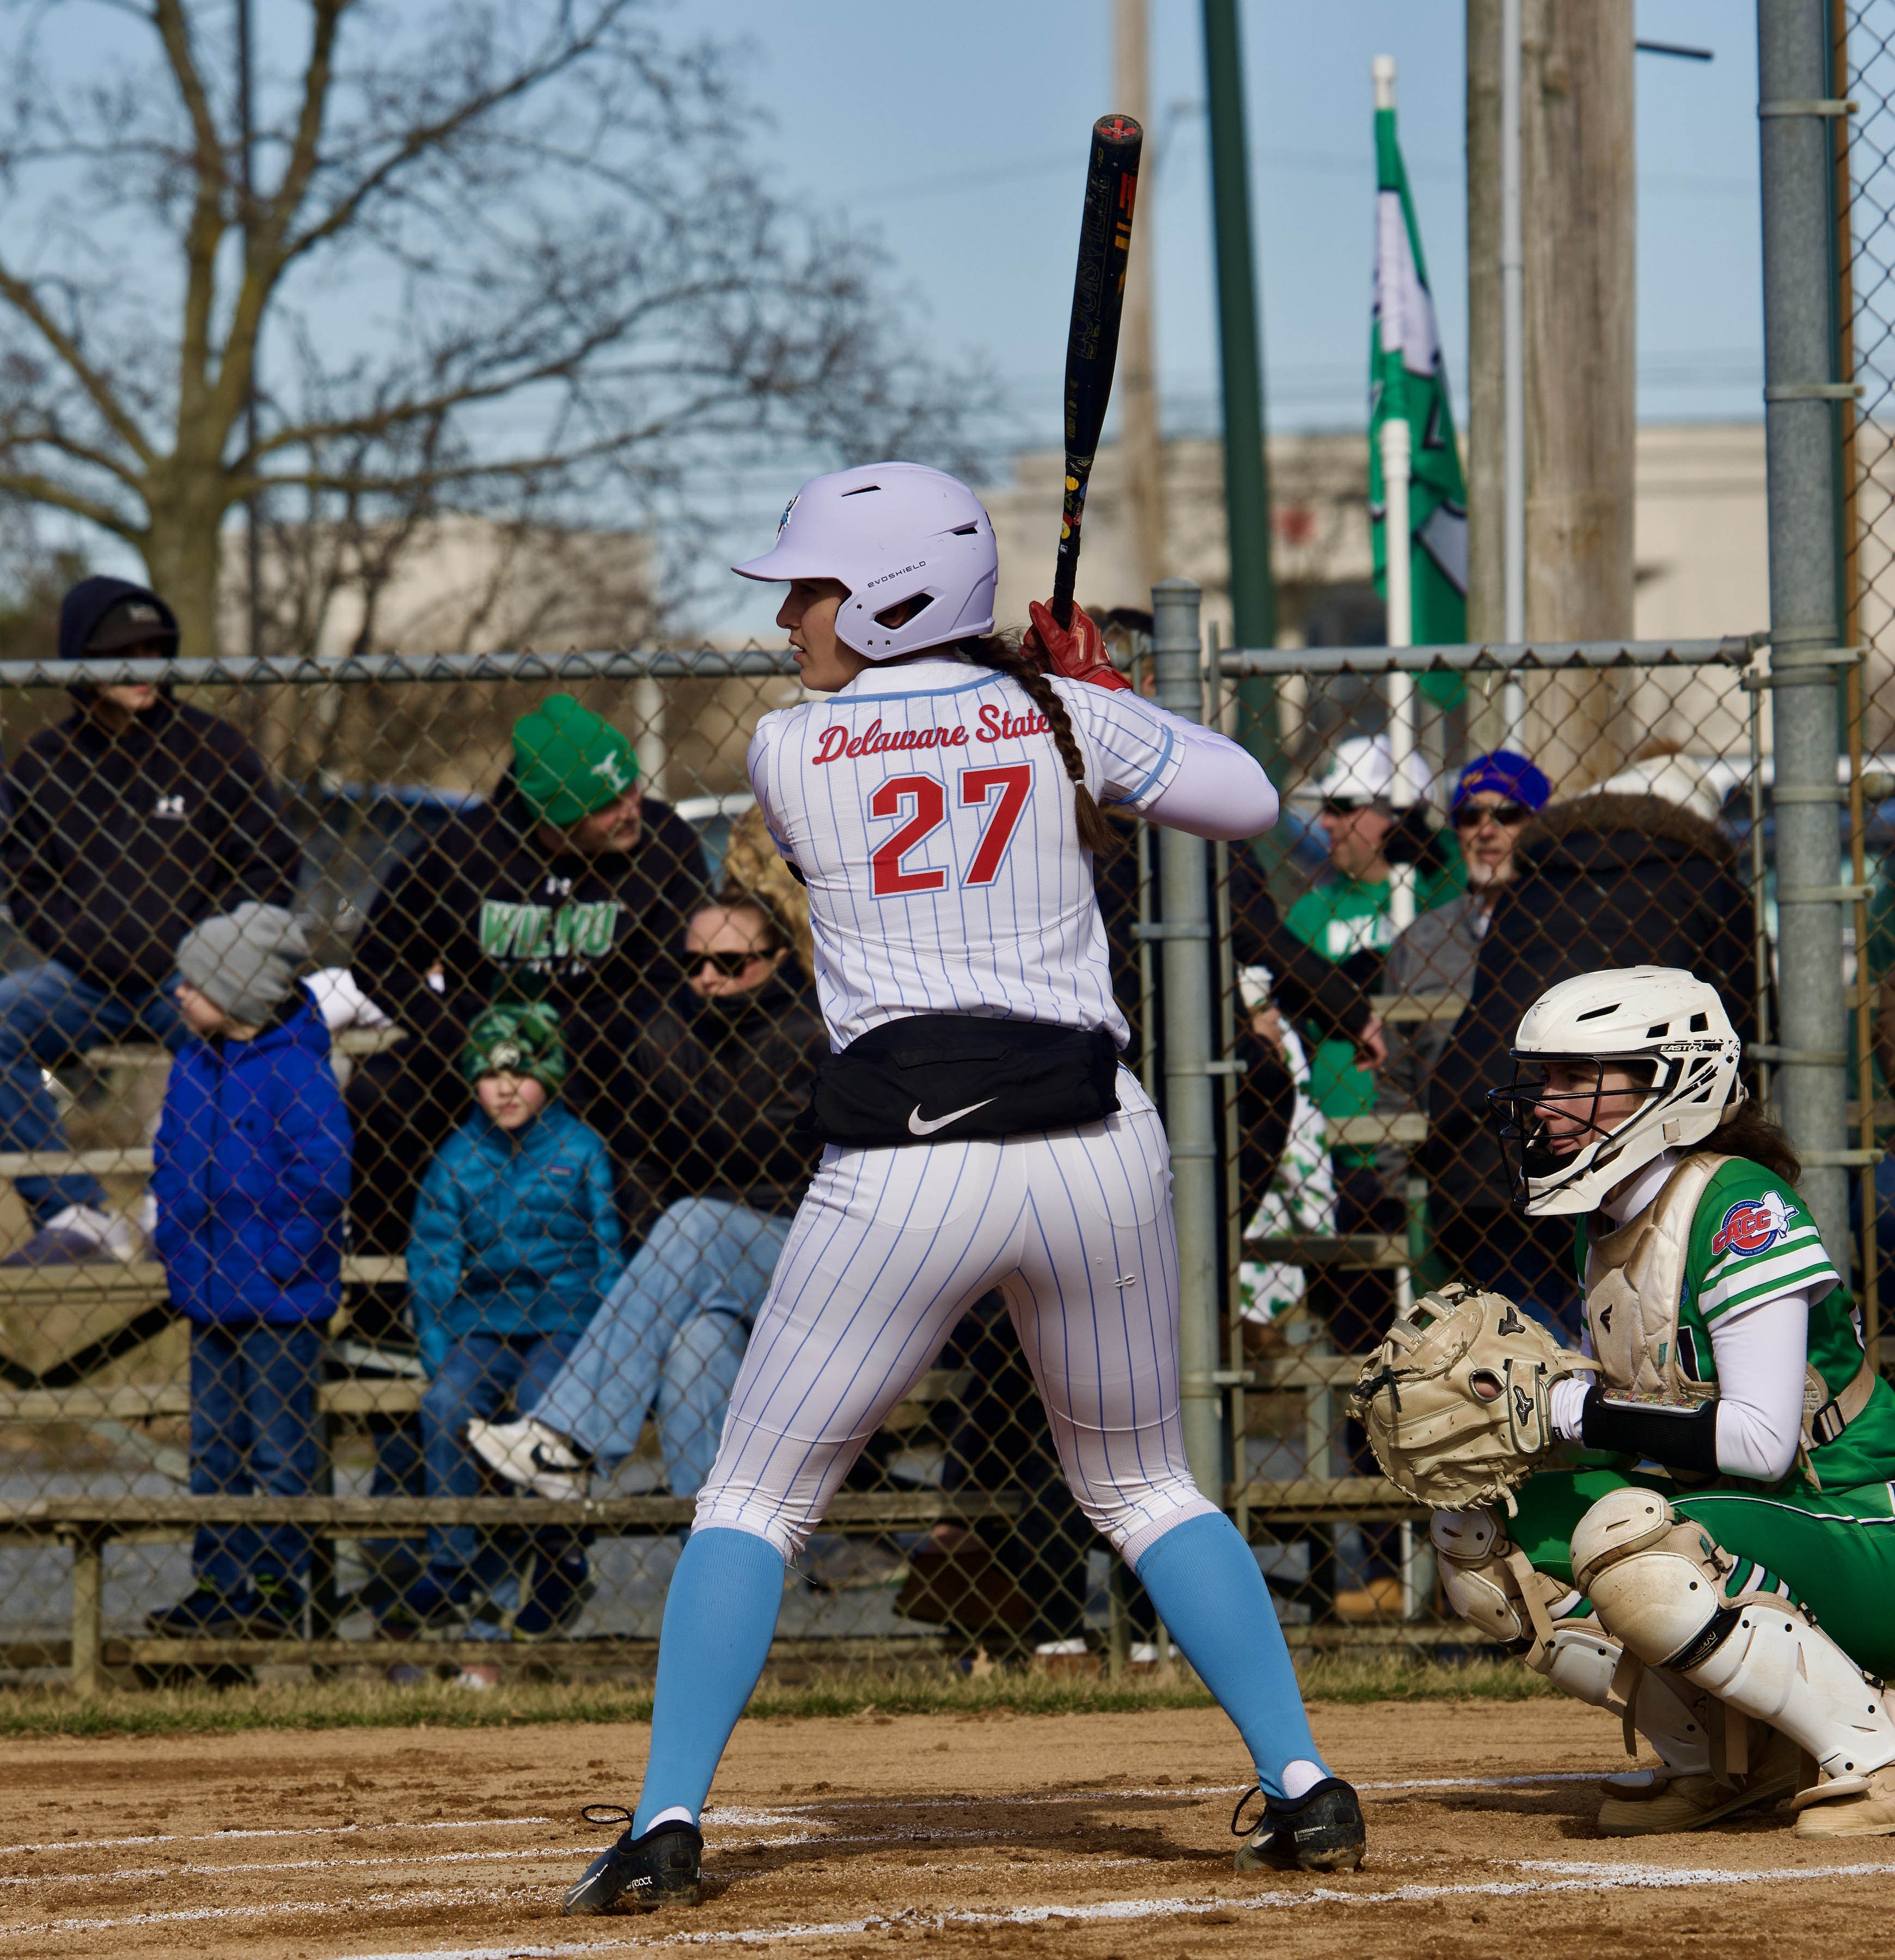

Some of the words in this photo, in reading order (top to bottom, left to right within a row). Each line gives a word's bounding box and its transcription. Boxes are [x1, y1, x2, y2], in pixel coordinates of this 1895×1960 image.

[812, 719, 969, 765] Delaware
[976, 704, 1051, 743] State
[867, 759, 1036, 901] 27
[1660, 1044, 1704, 1052] EASTON
[1713, 1209, 1771, 1255] CACC
[1724, 1208, 1737, 1226] CENTRAL
[1730, 1244, 1753, 1254] COLLEGIATE
[1754, 1233, 1775, 1253] CONFERENCE
